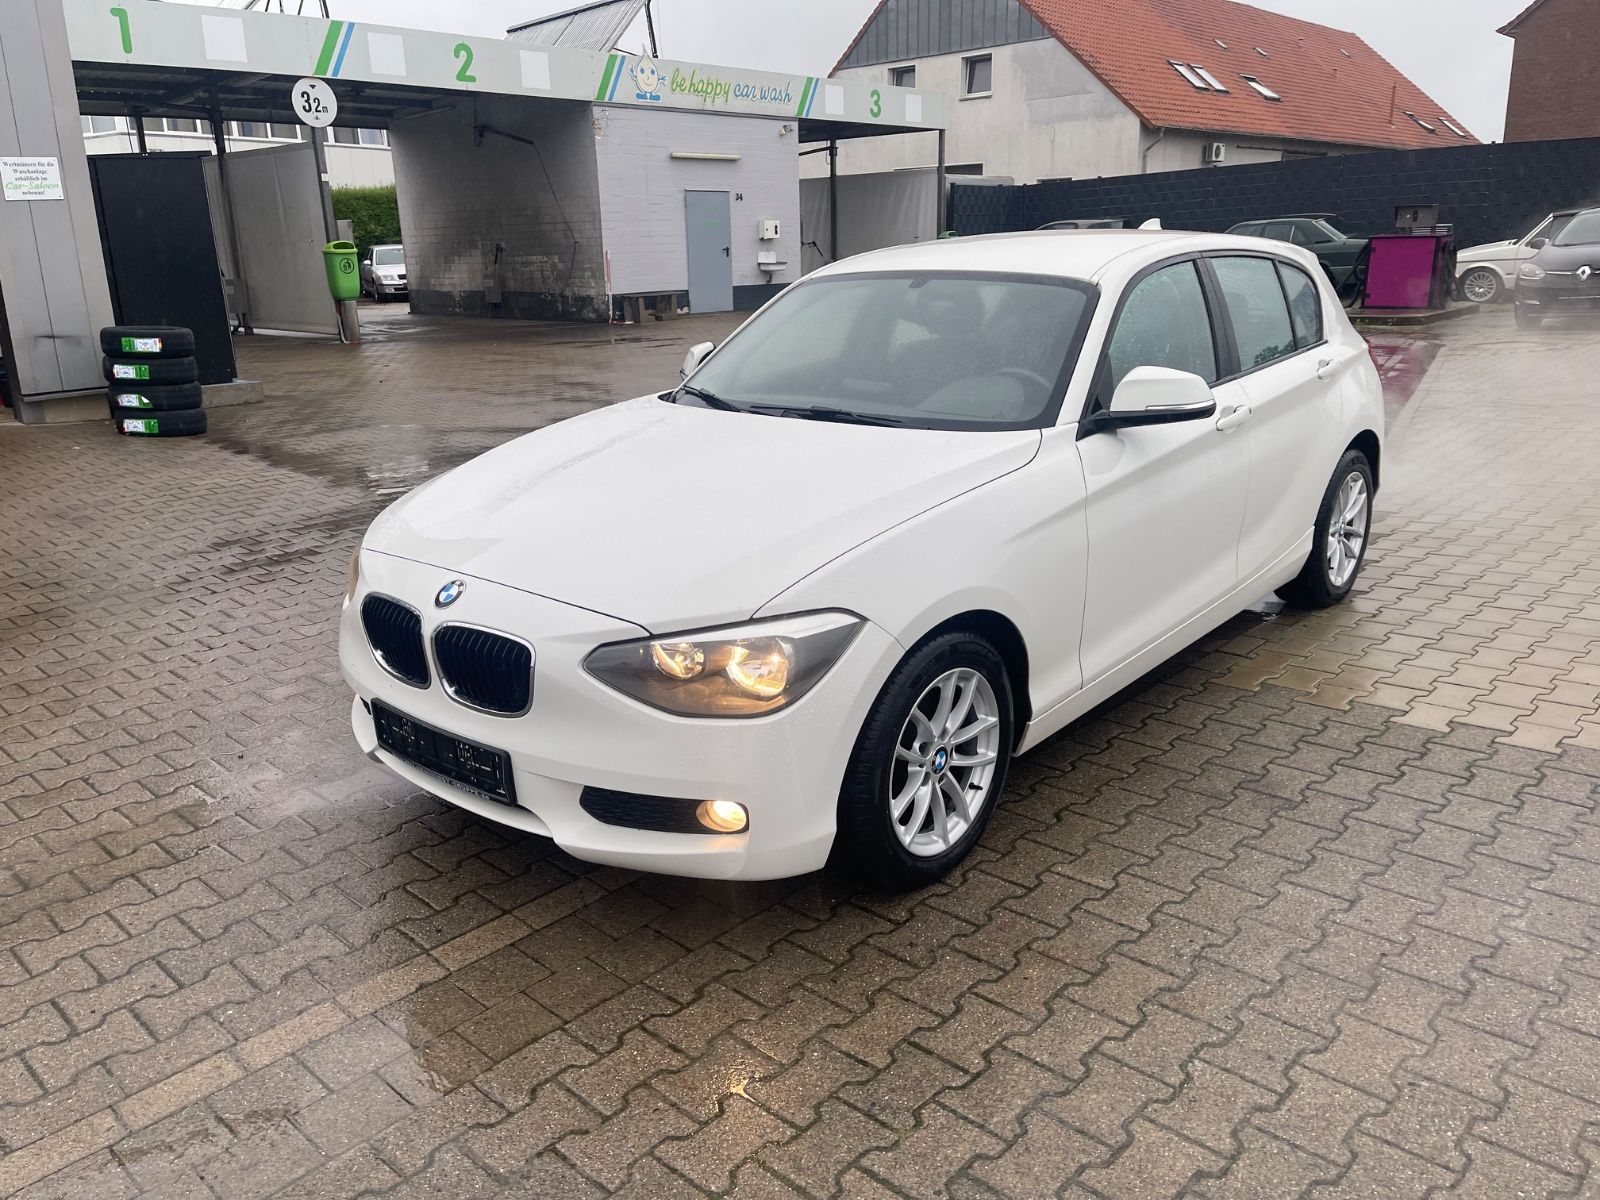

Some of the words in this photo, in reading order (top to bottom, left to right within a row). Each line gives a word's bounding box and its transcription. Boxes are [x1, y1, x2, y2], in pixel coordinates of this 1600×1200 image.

[110, 8, 133, 54] 1
[454, 43, 477, 83] 2
[670, 68, 686, 93] be
[687, 70, 732, 104] happy
[733, 82, 757, 100] car
[759, 80, 792, 103] wash
[870, 89, 882, 118] 3
[5, 182, 59, 190] Car-Saloon
[735, 192, 744, 201] 34
